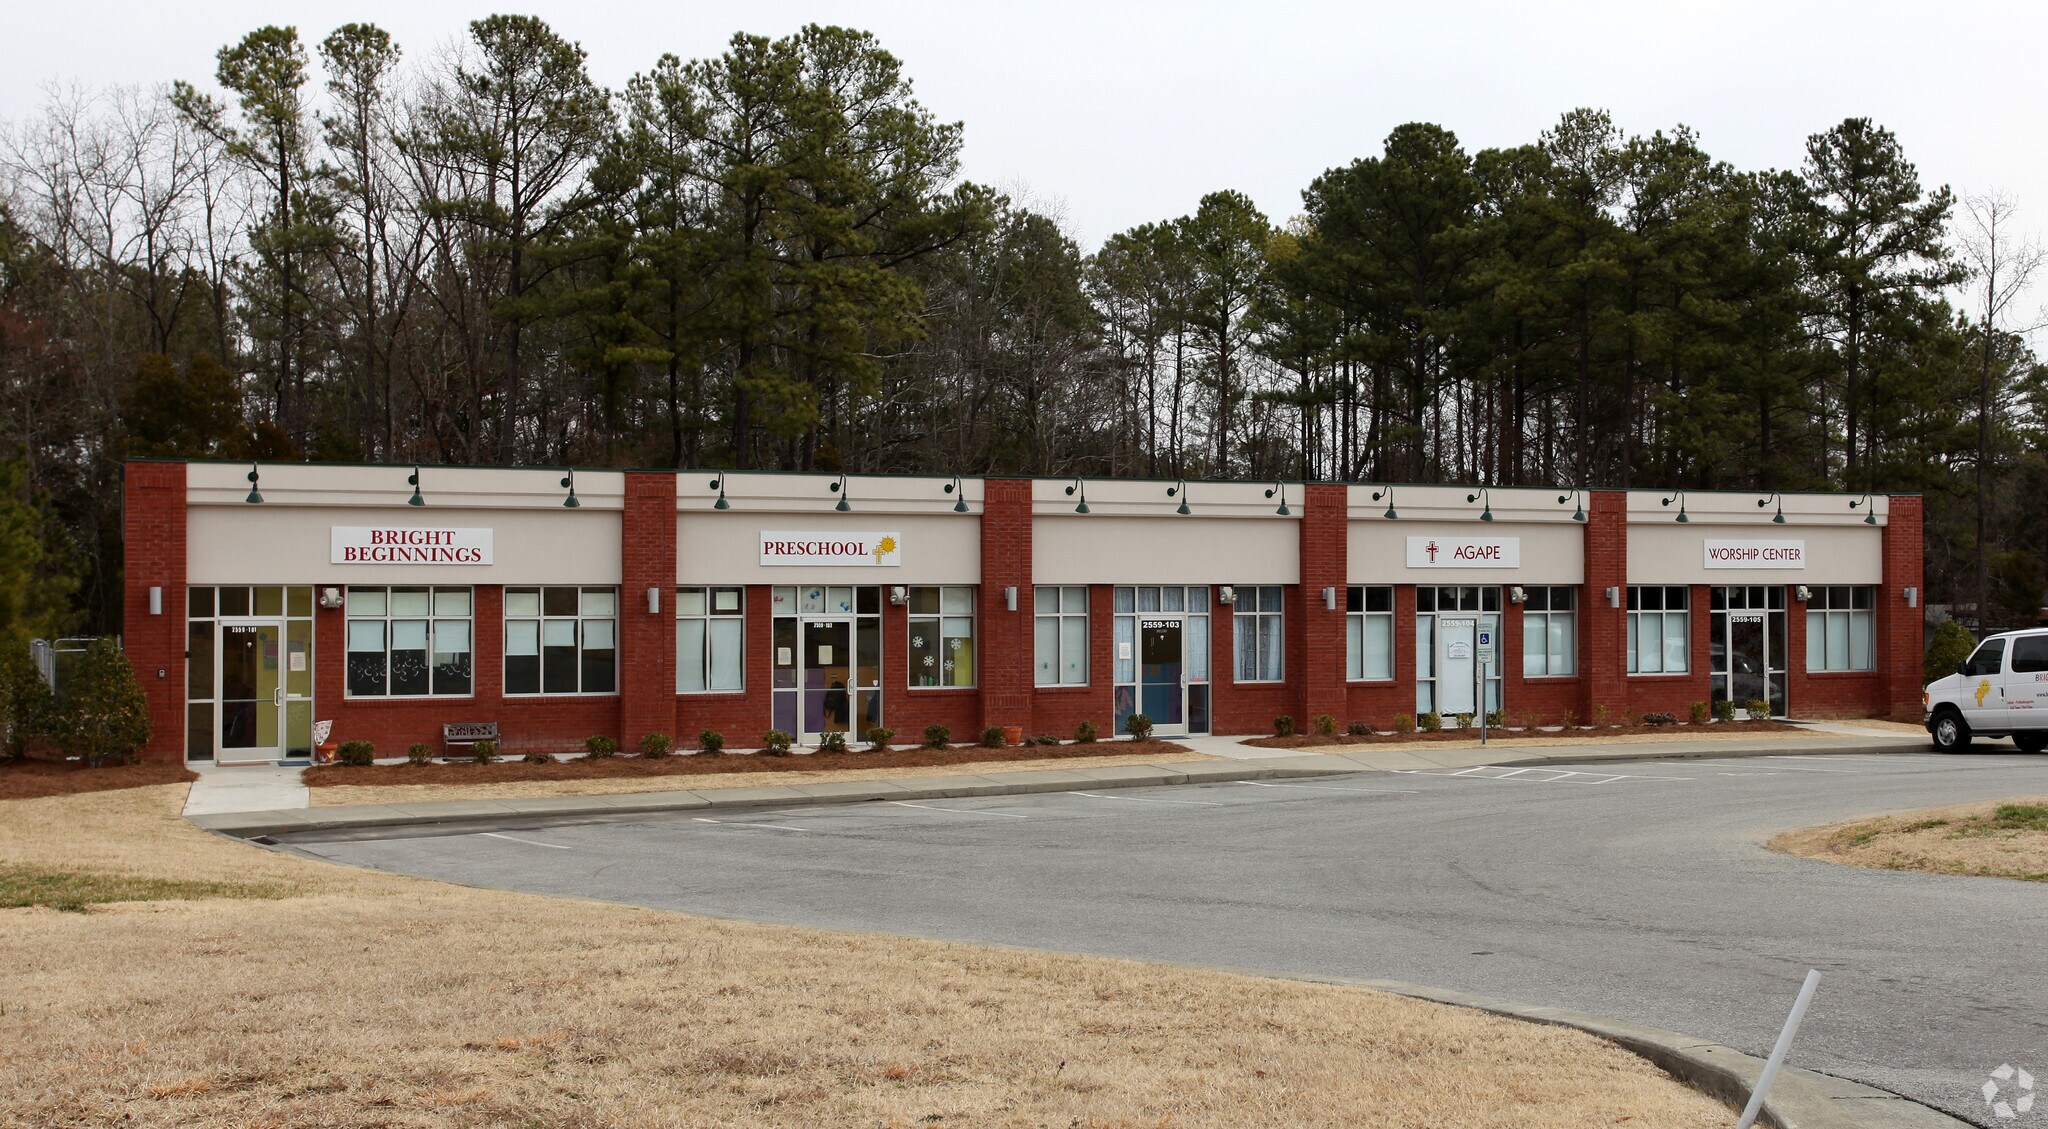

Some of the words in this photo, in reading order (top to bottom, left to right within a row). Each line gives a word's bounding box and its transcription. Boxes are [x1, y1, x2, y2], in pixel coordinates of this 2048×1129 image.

[371, 530, 456, 545] BRIGHT
[344, 546, 481, 562] BEGINNINGS
[764, 542, 868, 556] PRESCHOOL
[1454, 545, 1501, 559] AGAPE
[1709, 548, 1759, 560] WORSHIP
[1762, 548, 1801, 560] CENTER
[1142, 621, 1180, 629] 2559-103
